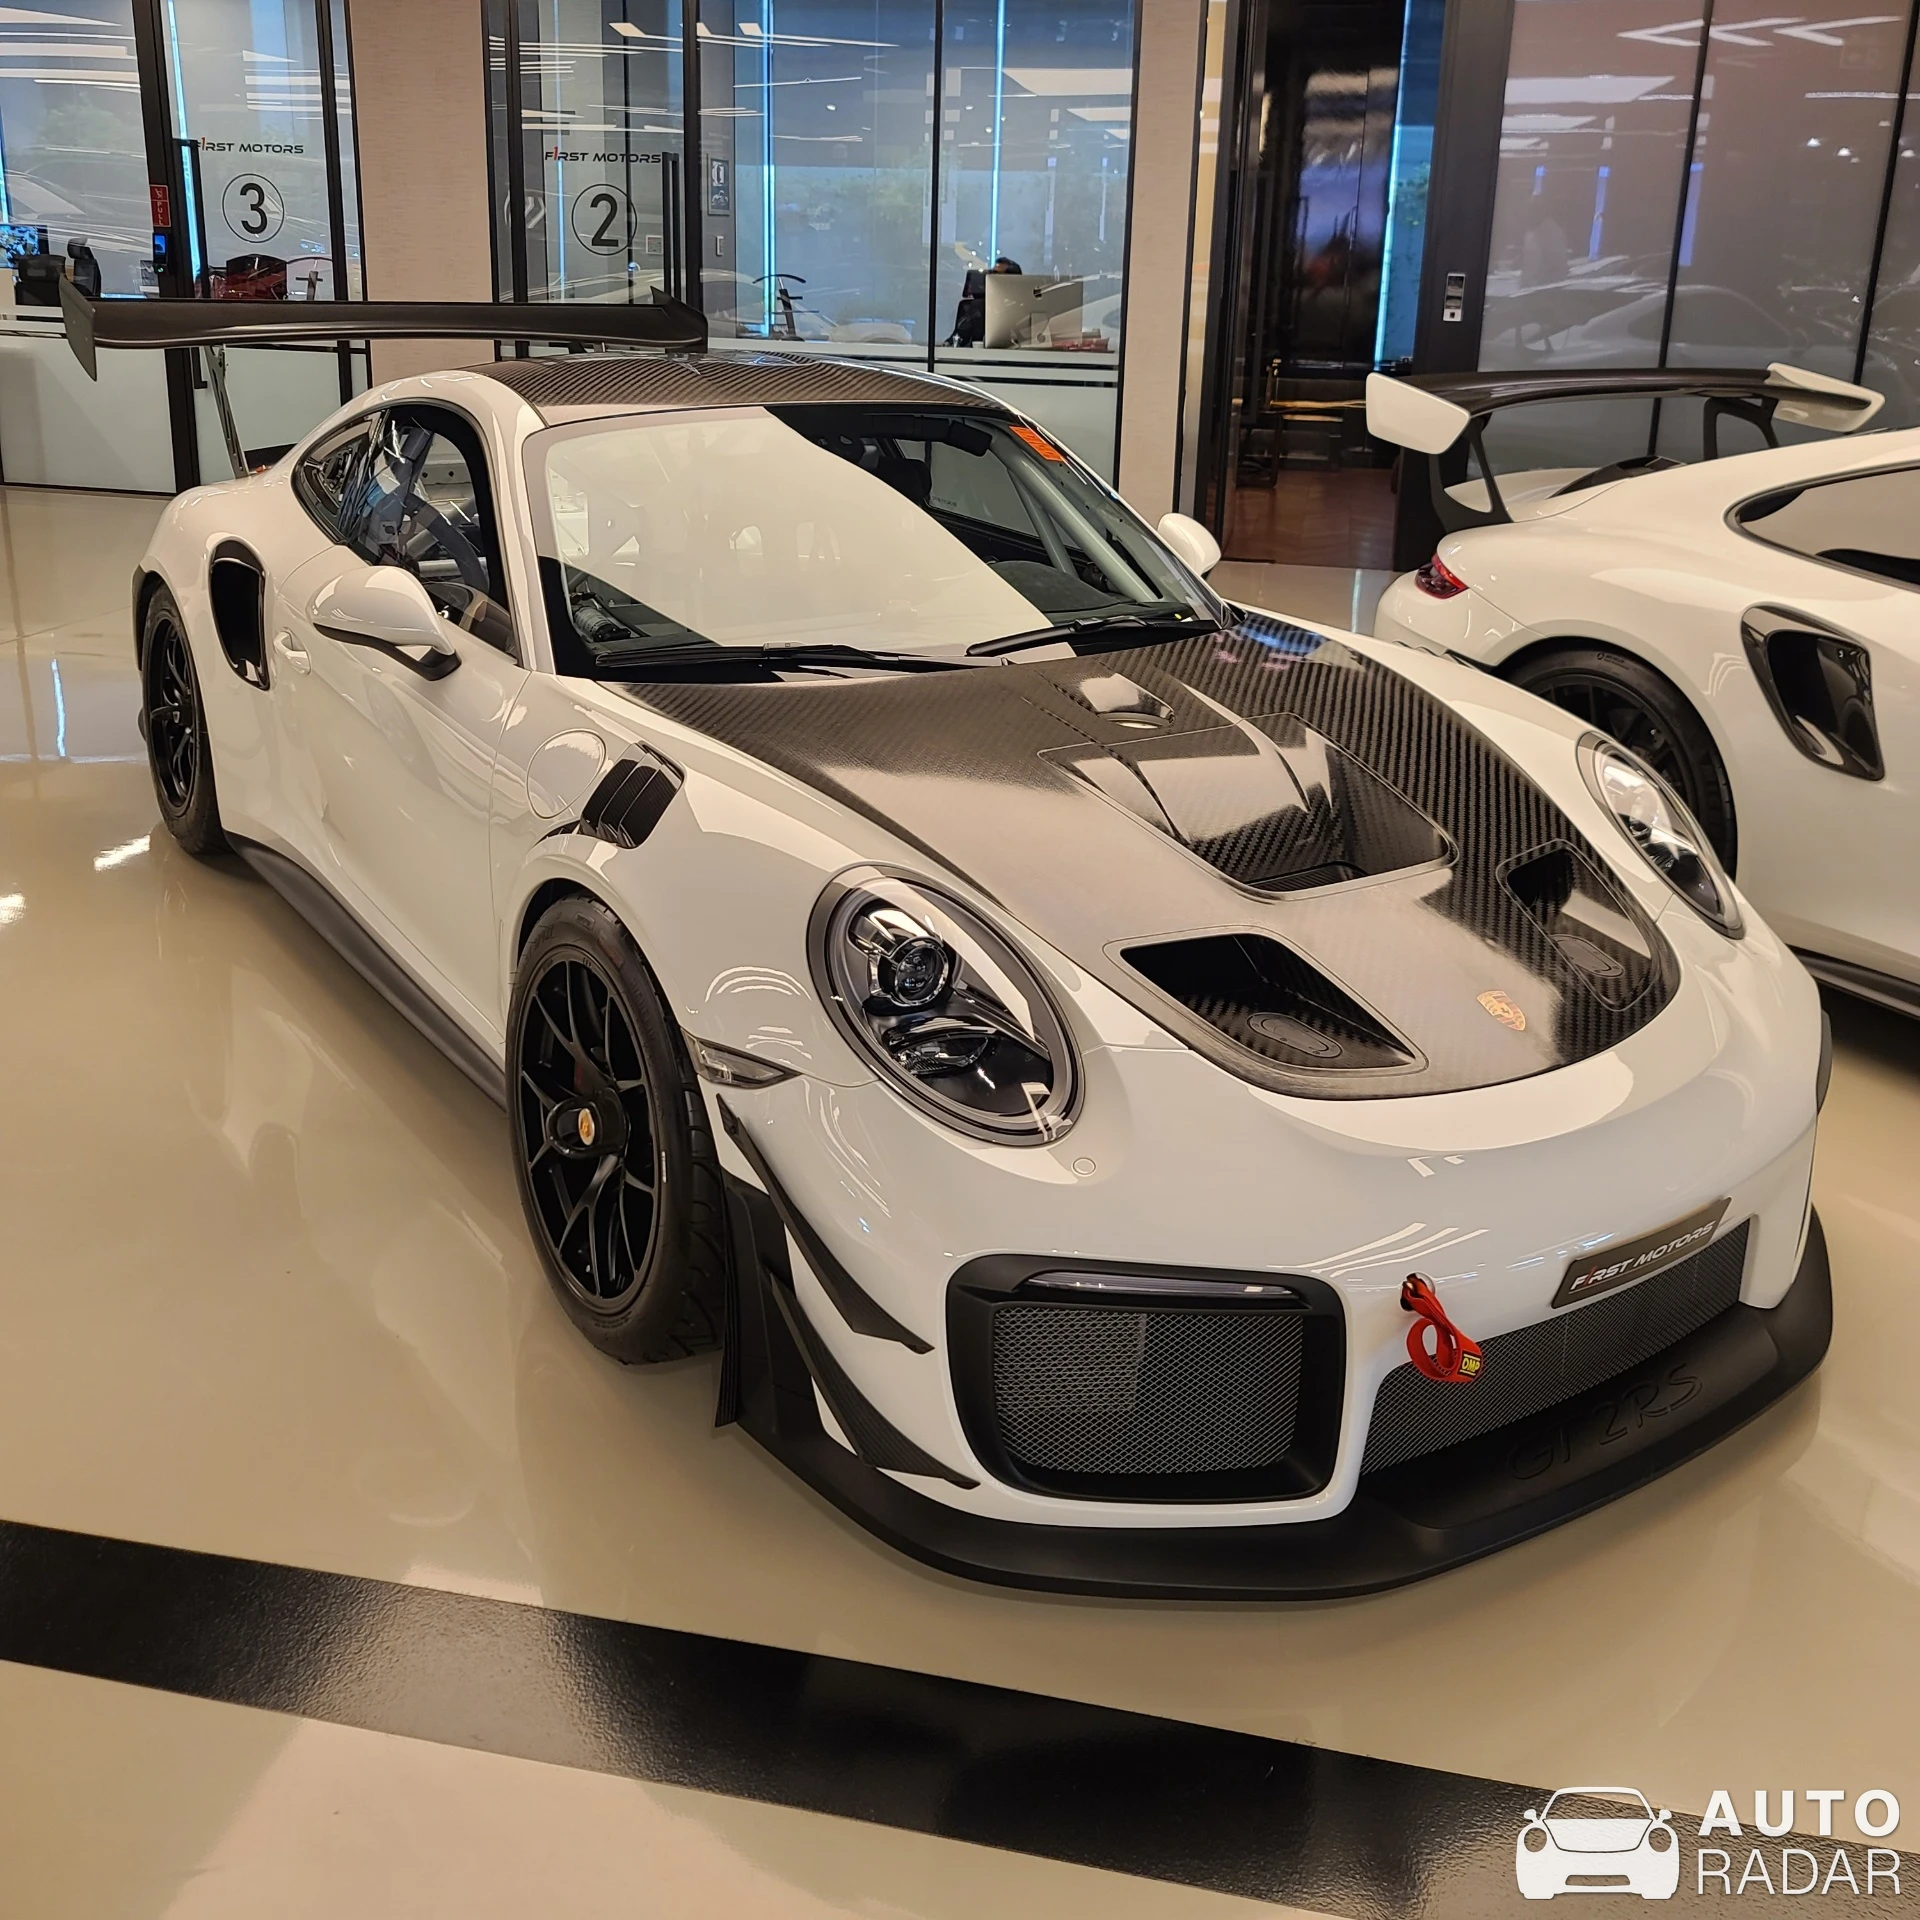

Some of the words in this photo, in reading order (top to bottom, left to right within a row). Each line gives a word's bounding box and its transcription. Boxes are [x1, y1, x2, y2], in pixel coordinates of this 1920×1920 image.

[239, 143, 304, 154] MOTORS
[593, 152, 661, 164] MOTORS
[240, 183, 267, 234] 3
[590, 193, 619, 247] 2
[1633, 1220, 1716, 1268] MOTORS
[1462, 1357, 1481, 1373] OMP
